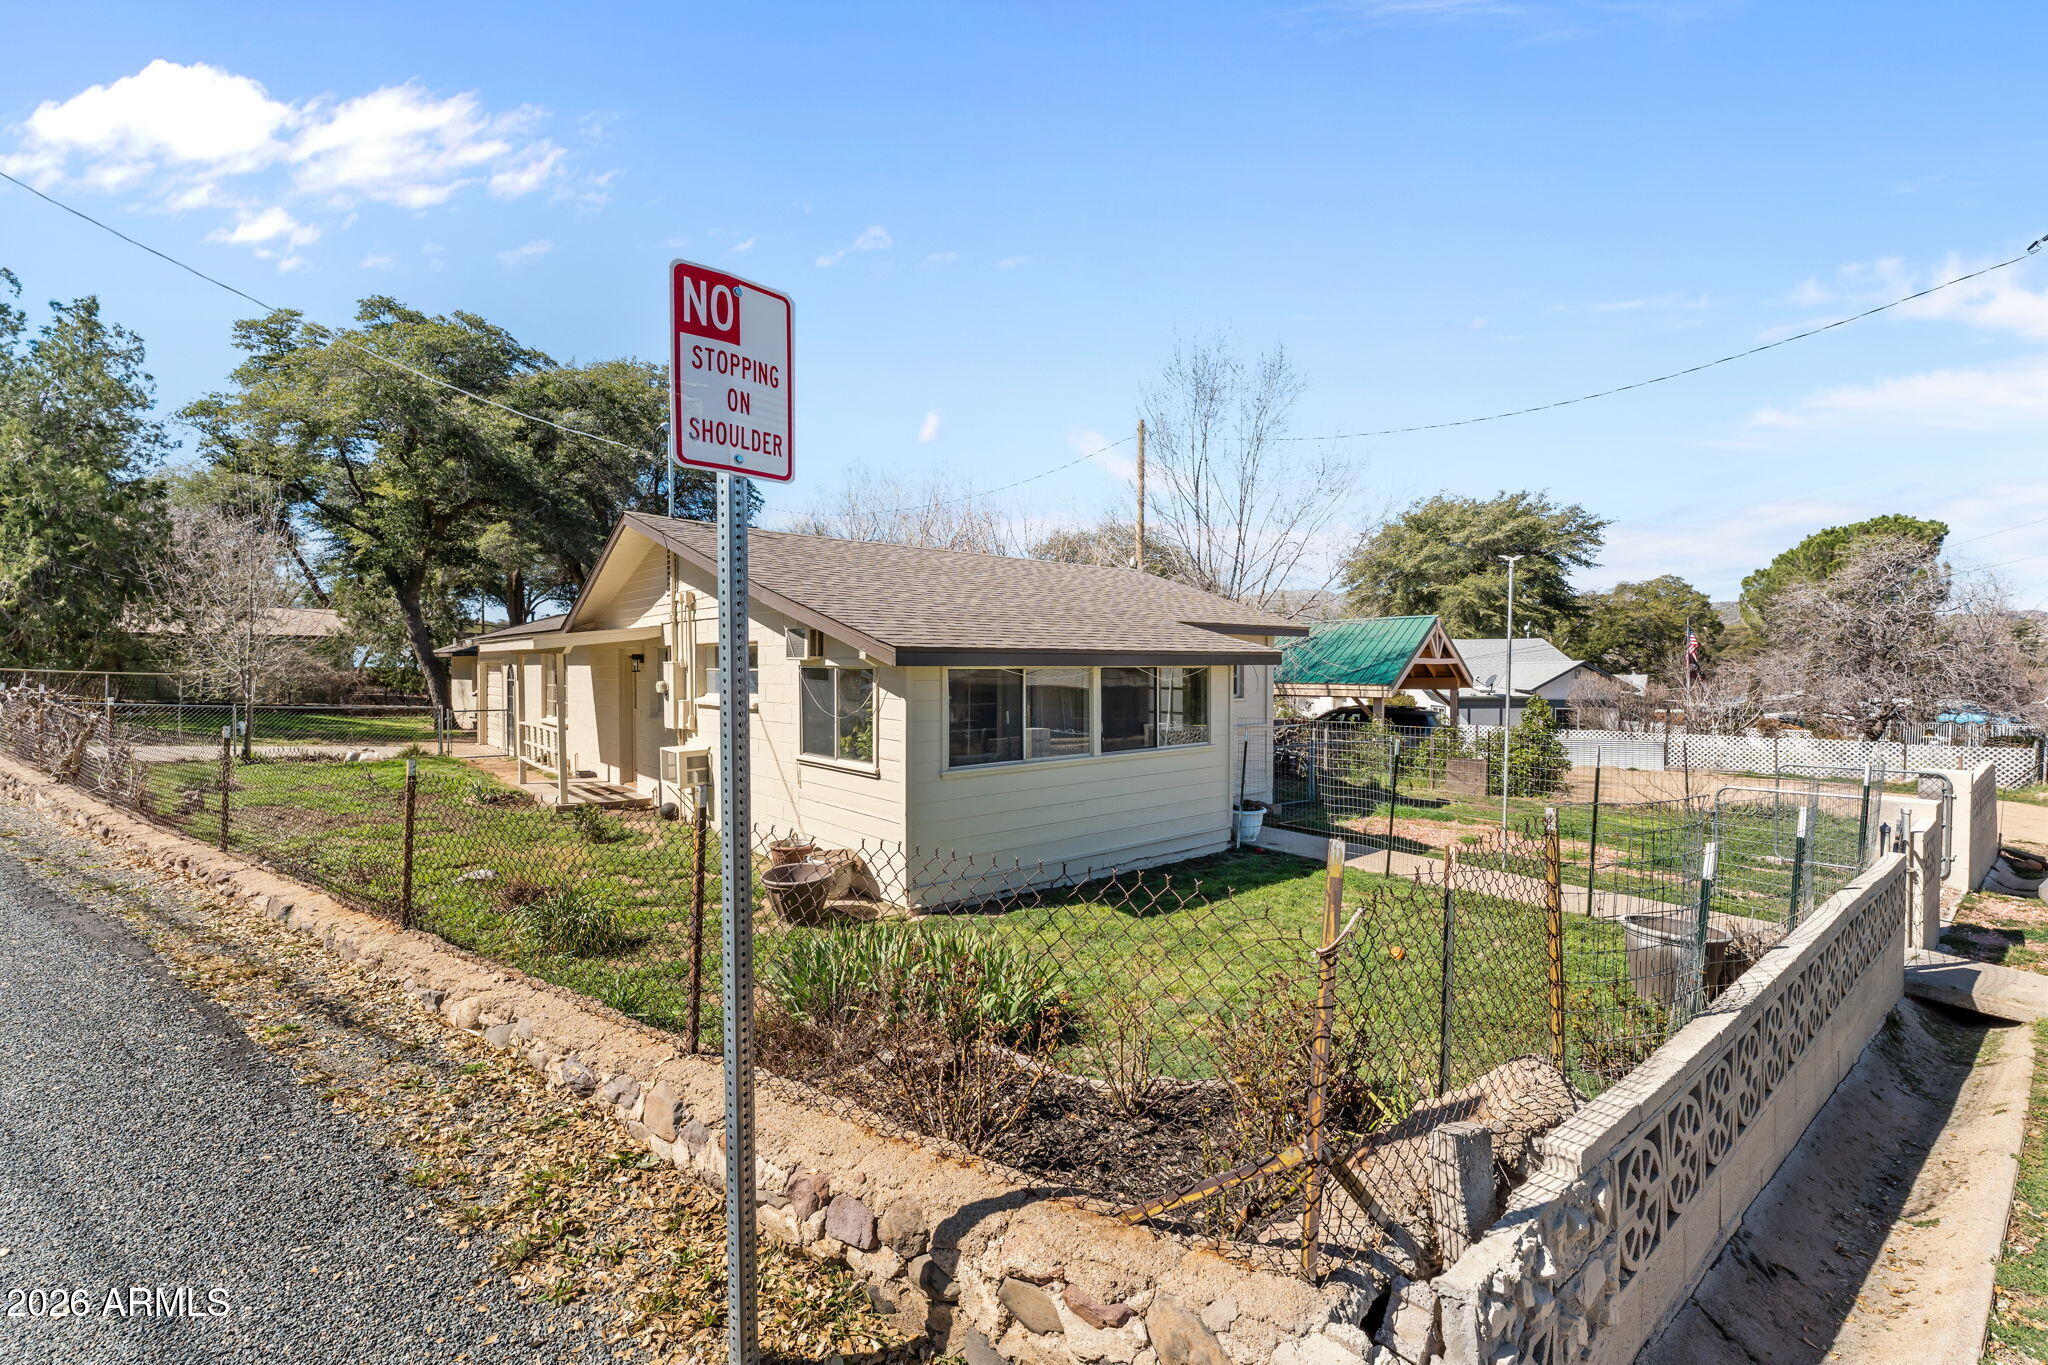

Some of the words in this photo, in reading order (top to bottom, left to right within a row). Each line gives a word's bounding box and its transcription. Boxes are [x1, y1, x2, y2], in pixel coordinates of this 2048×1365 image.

[683, 275, 734, 332] NO
[691, 345, 779, 389] STOPPING
[727, 388, 750, 416] ON
[688, 417, 783, 458] SHOULDER
